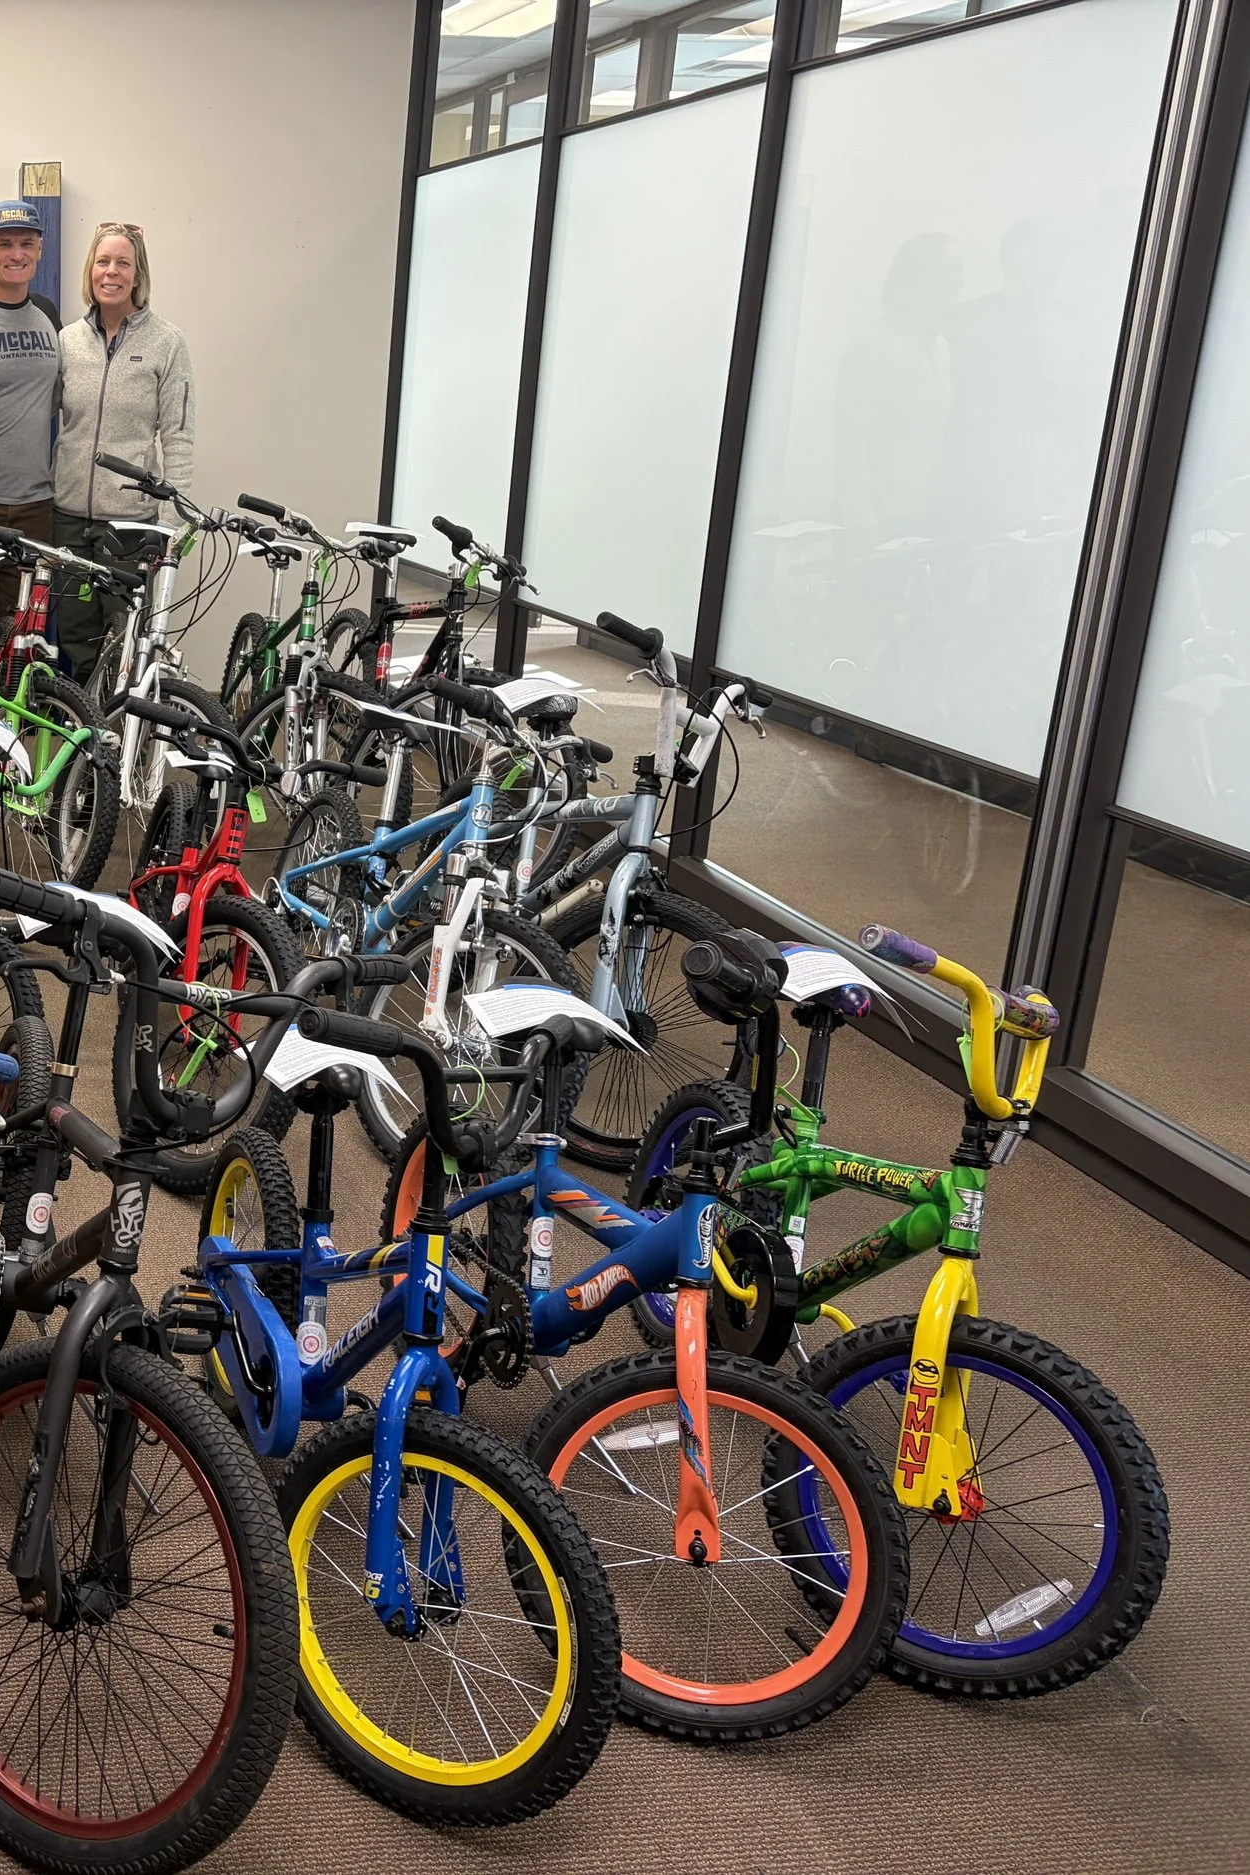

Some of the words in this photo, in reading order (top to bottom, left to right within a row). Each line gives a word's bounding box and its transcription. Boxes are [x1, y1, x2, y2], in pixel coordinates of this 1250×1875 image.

[578, 834, 618, 874] MONGOOSE
[834, 1160, 877, 1184] TURTLE
[876, 1167, 915, 1190] POWER
[322, 1302, 380, 1373] RALEIGH
[898, 1384, 938, 1490] TMNT
